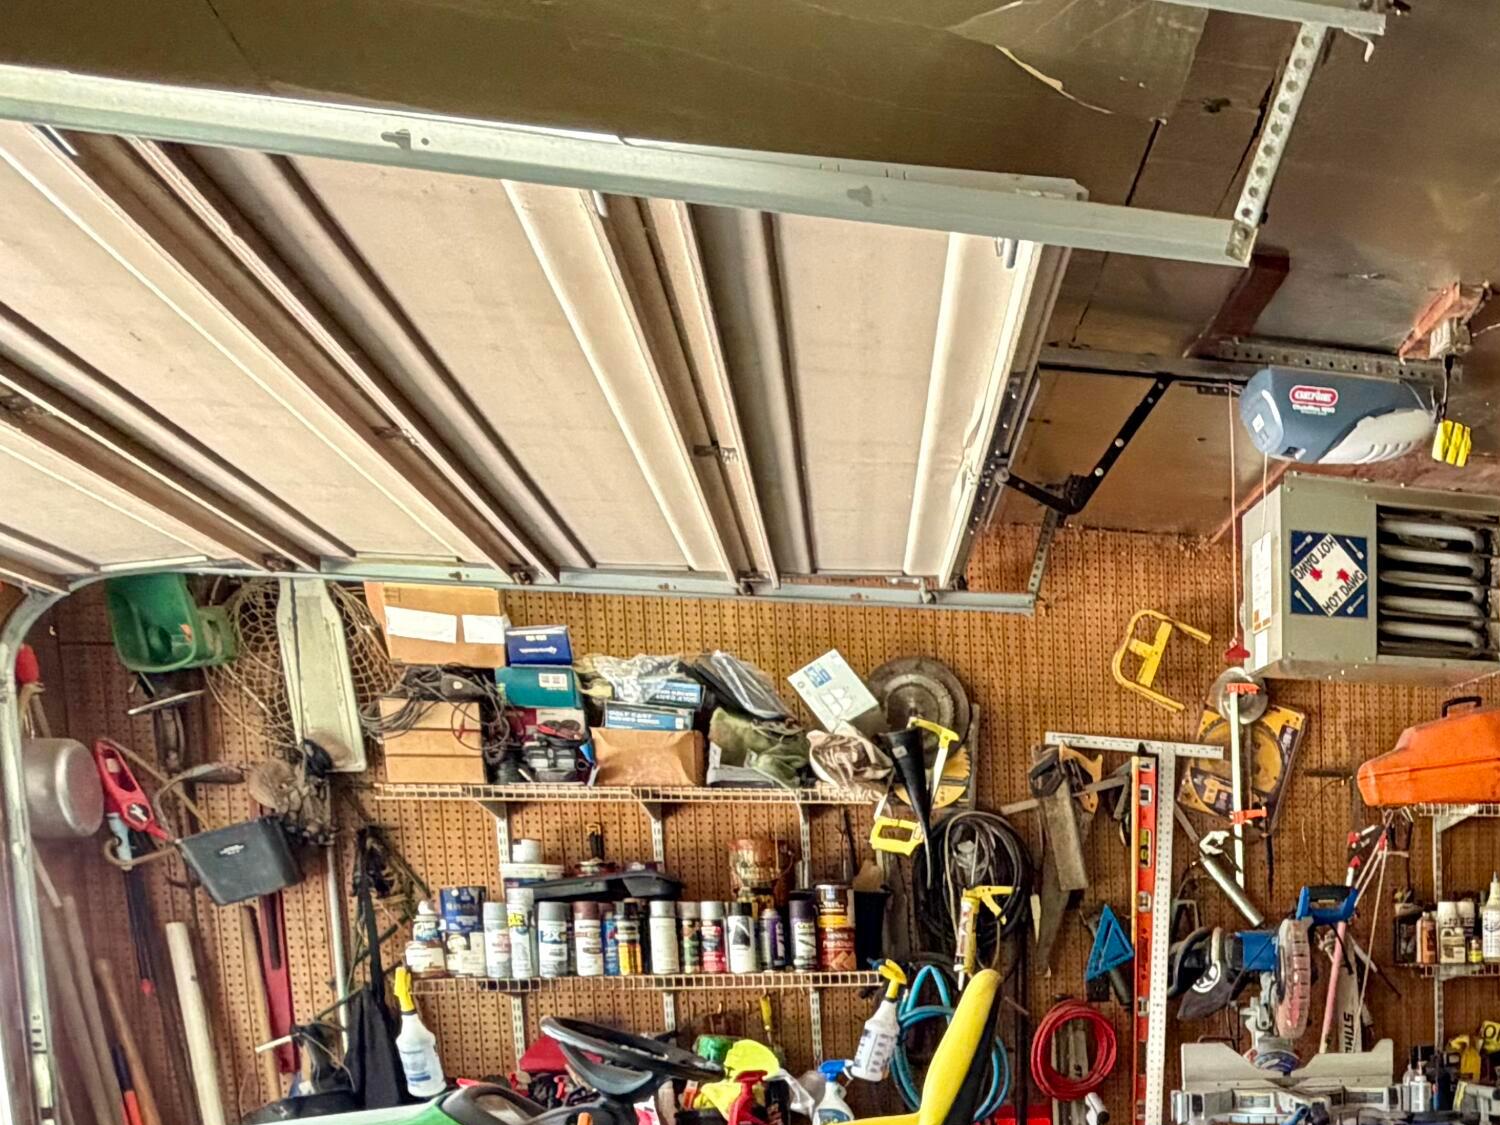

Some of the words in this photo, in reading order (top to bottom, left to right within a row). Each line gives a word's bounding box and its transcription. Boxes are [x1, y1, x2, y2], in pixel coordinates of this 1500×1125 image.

[1316, 536, 1337, 559] HOT
[1294, 553, 1320, 580] DAWG
[1321, 591, 1342, 613] HOT
[1340, 570, 1365, 596] DAWG
[1343, 1011, 1354, 1054] STIHL
